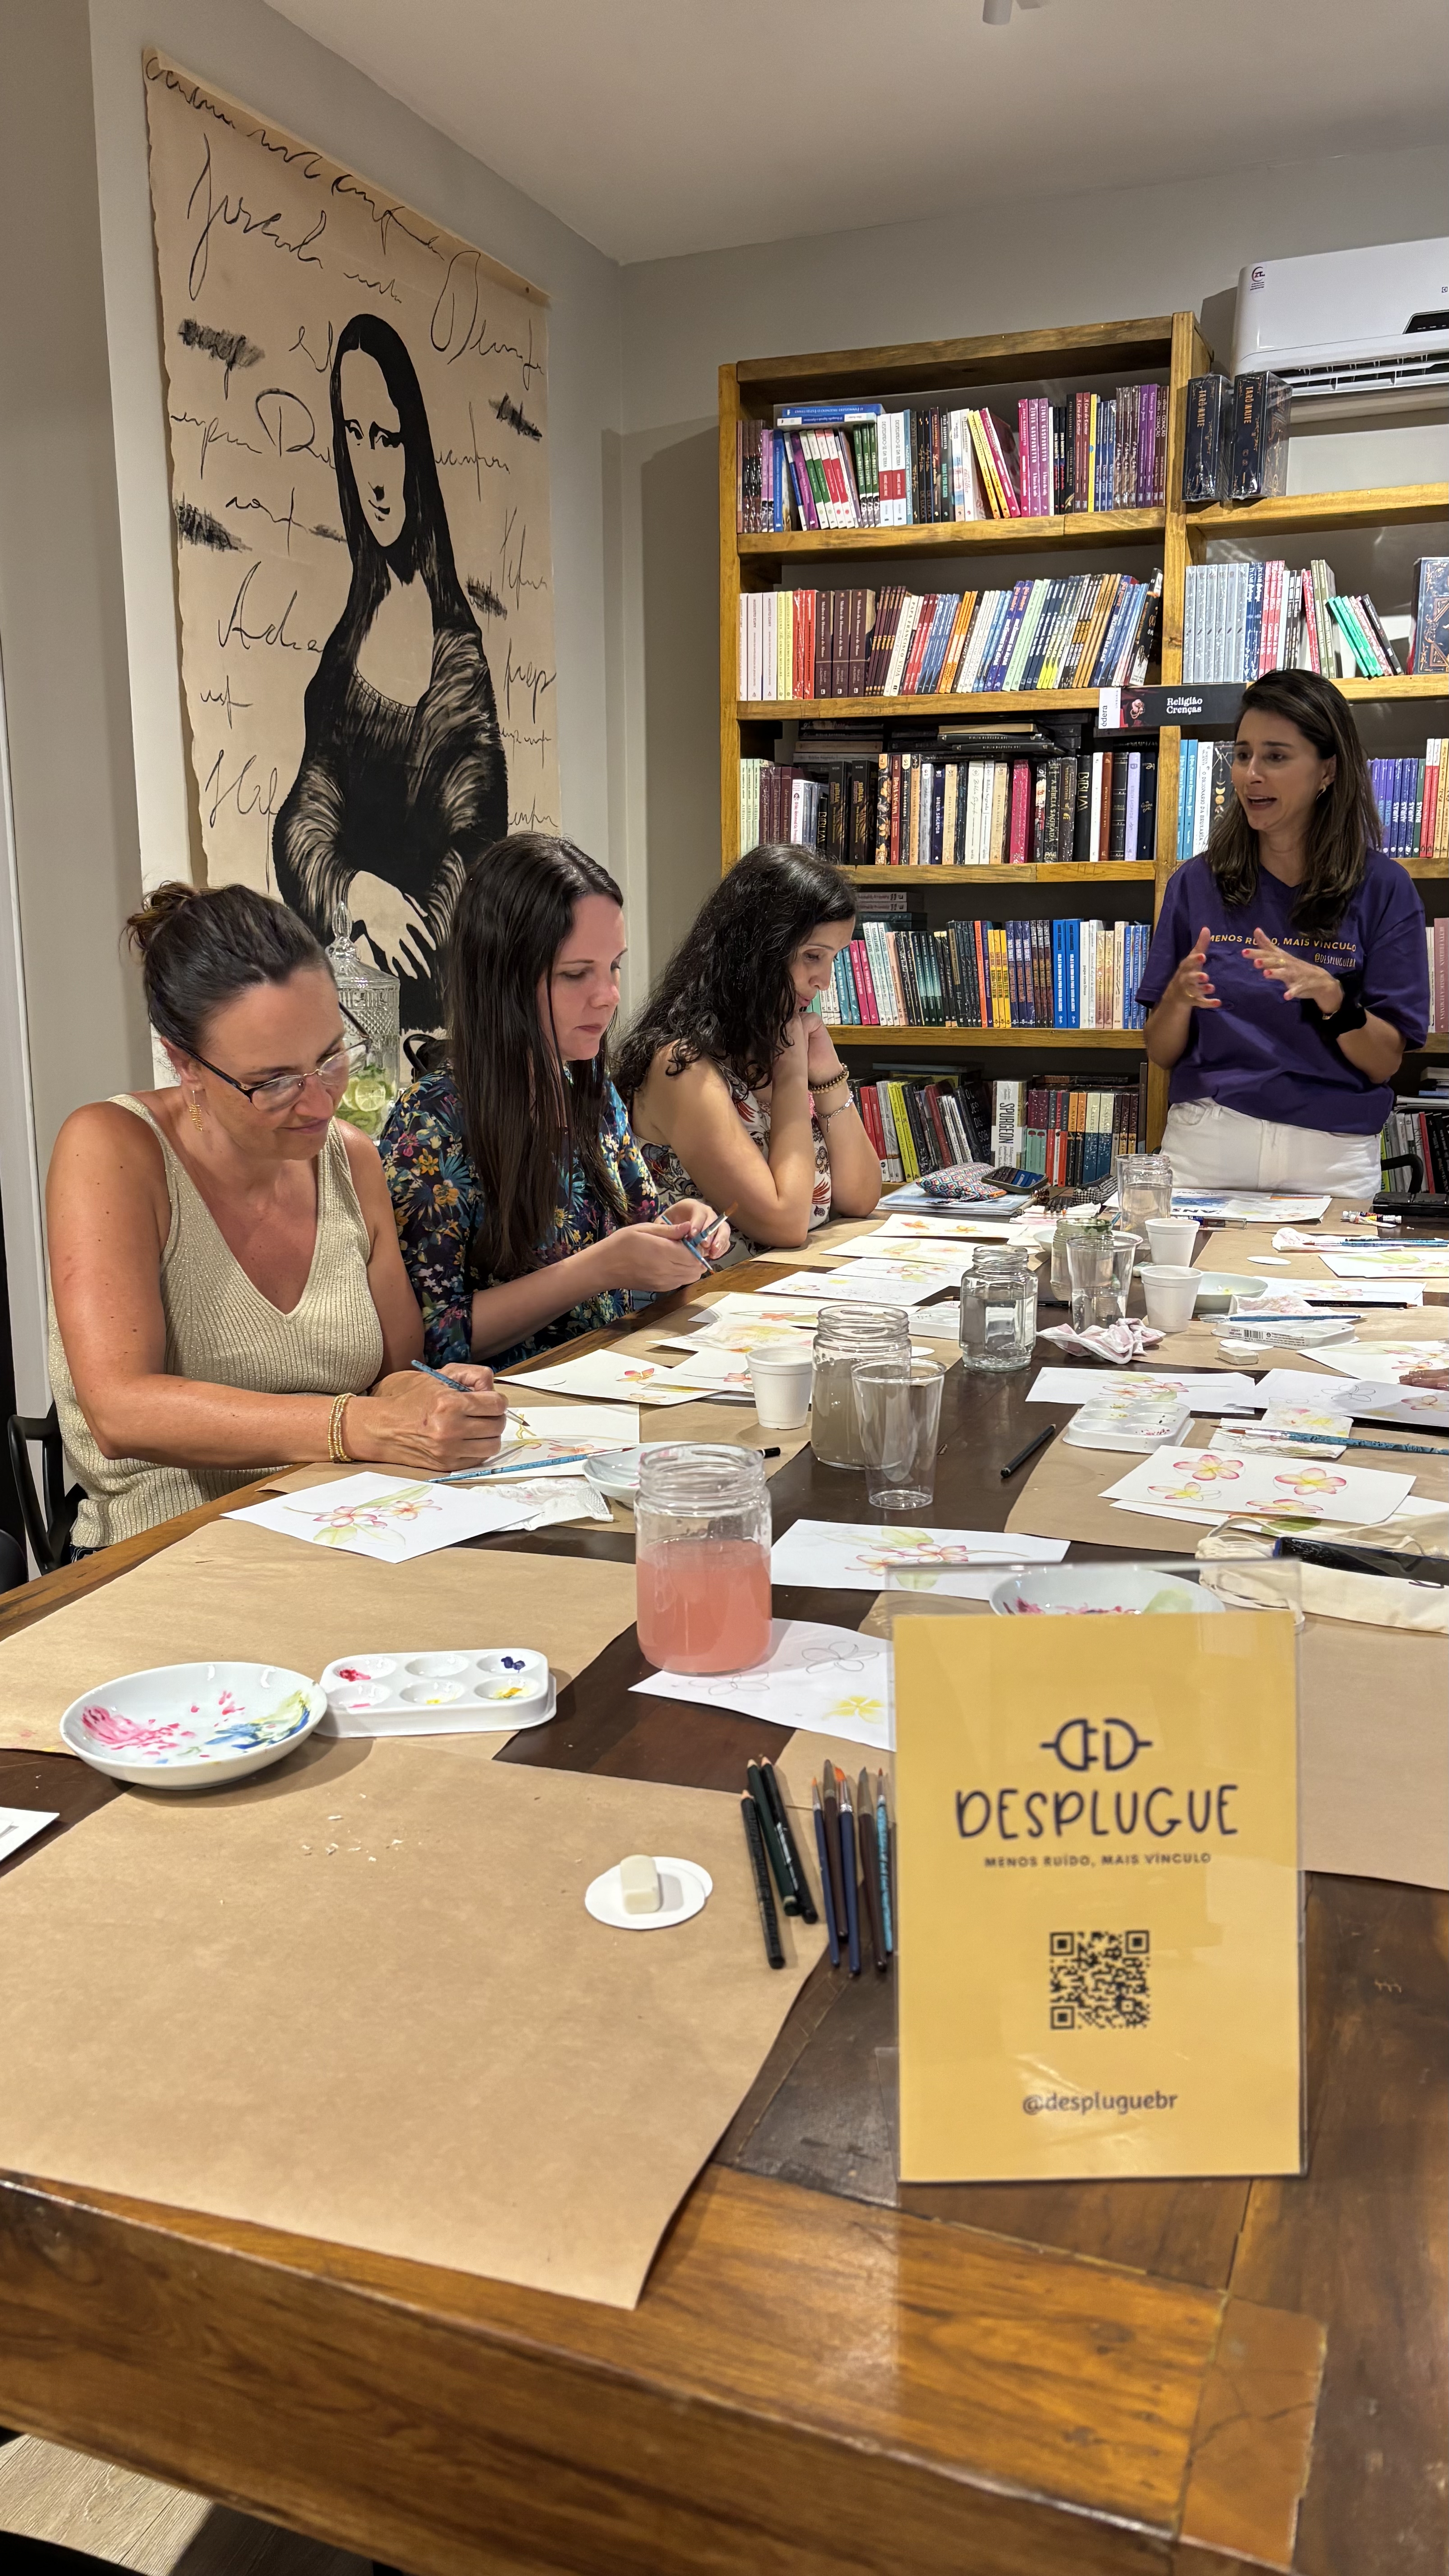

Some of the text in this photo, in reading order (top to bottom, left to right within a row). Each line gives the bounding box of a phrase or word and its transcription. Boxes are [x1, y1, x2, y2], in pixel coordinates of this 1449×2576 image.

[900, 621, 911, 657] FRANCISCO
[895, 661, 903, 677] VIDA
[1167, 697, 1203, 706] Religião
[1166, 706, 1202, 715] Crenças
[1283, 938, 1310, 946] MAIS
[998, 1103, 1015, 1144] SPURGEON
[955, 1784, 1239, 1841] DESPLUGUE
[984, 1852, 1211, 1868] MENOS RUÍDO, MAIS VÍNCULO
[1022, 2090, 1178, 2116] @despluguebr
